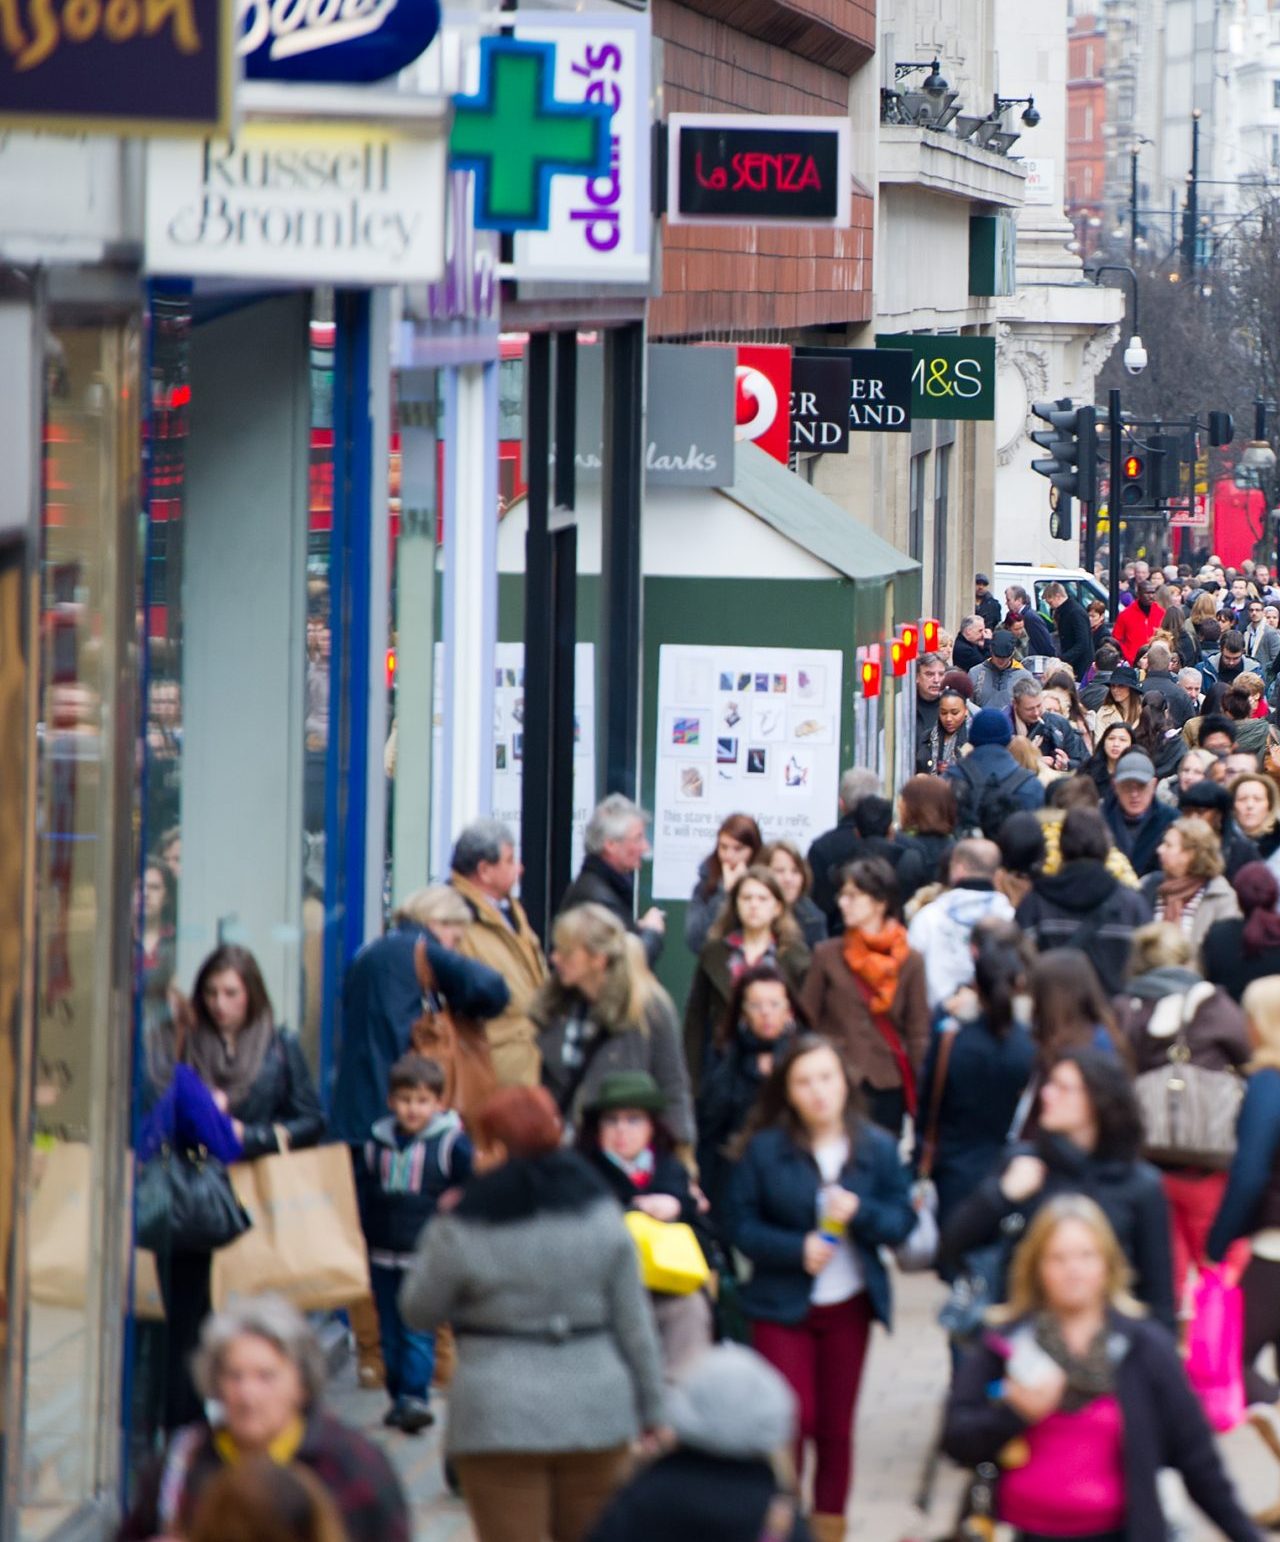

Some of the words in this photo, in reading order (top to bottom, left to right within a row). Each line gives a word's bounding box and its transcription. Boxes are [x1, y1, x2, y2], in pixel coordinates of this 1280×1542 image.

[200, 137, 390, 192] Russell
[731, 152, 822, 192] SENZA
[166, 194, 420, 262] Bromley
